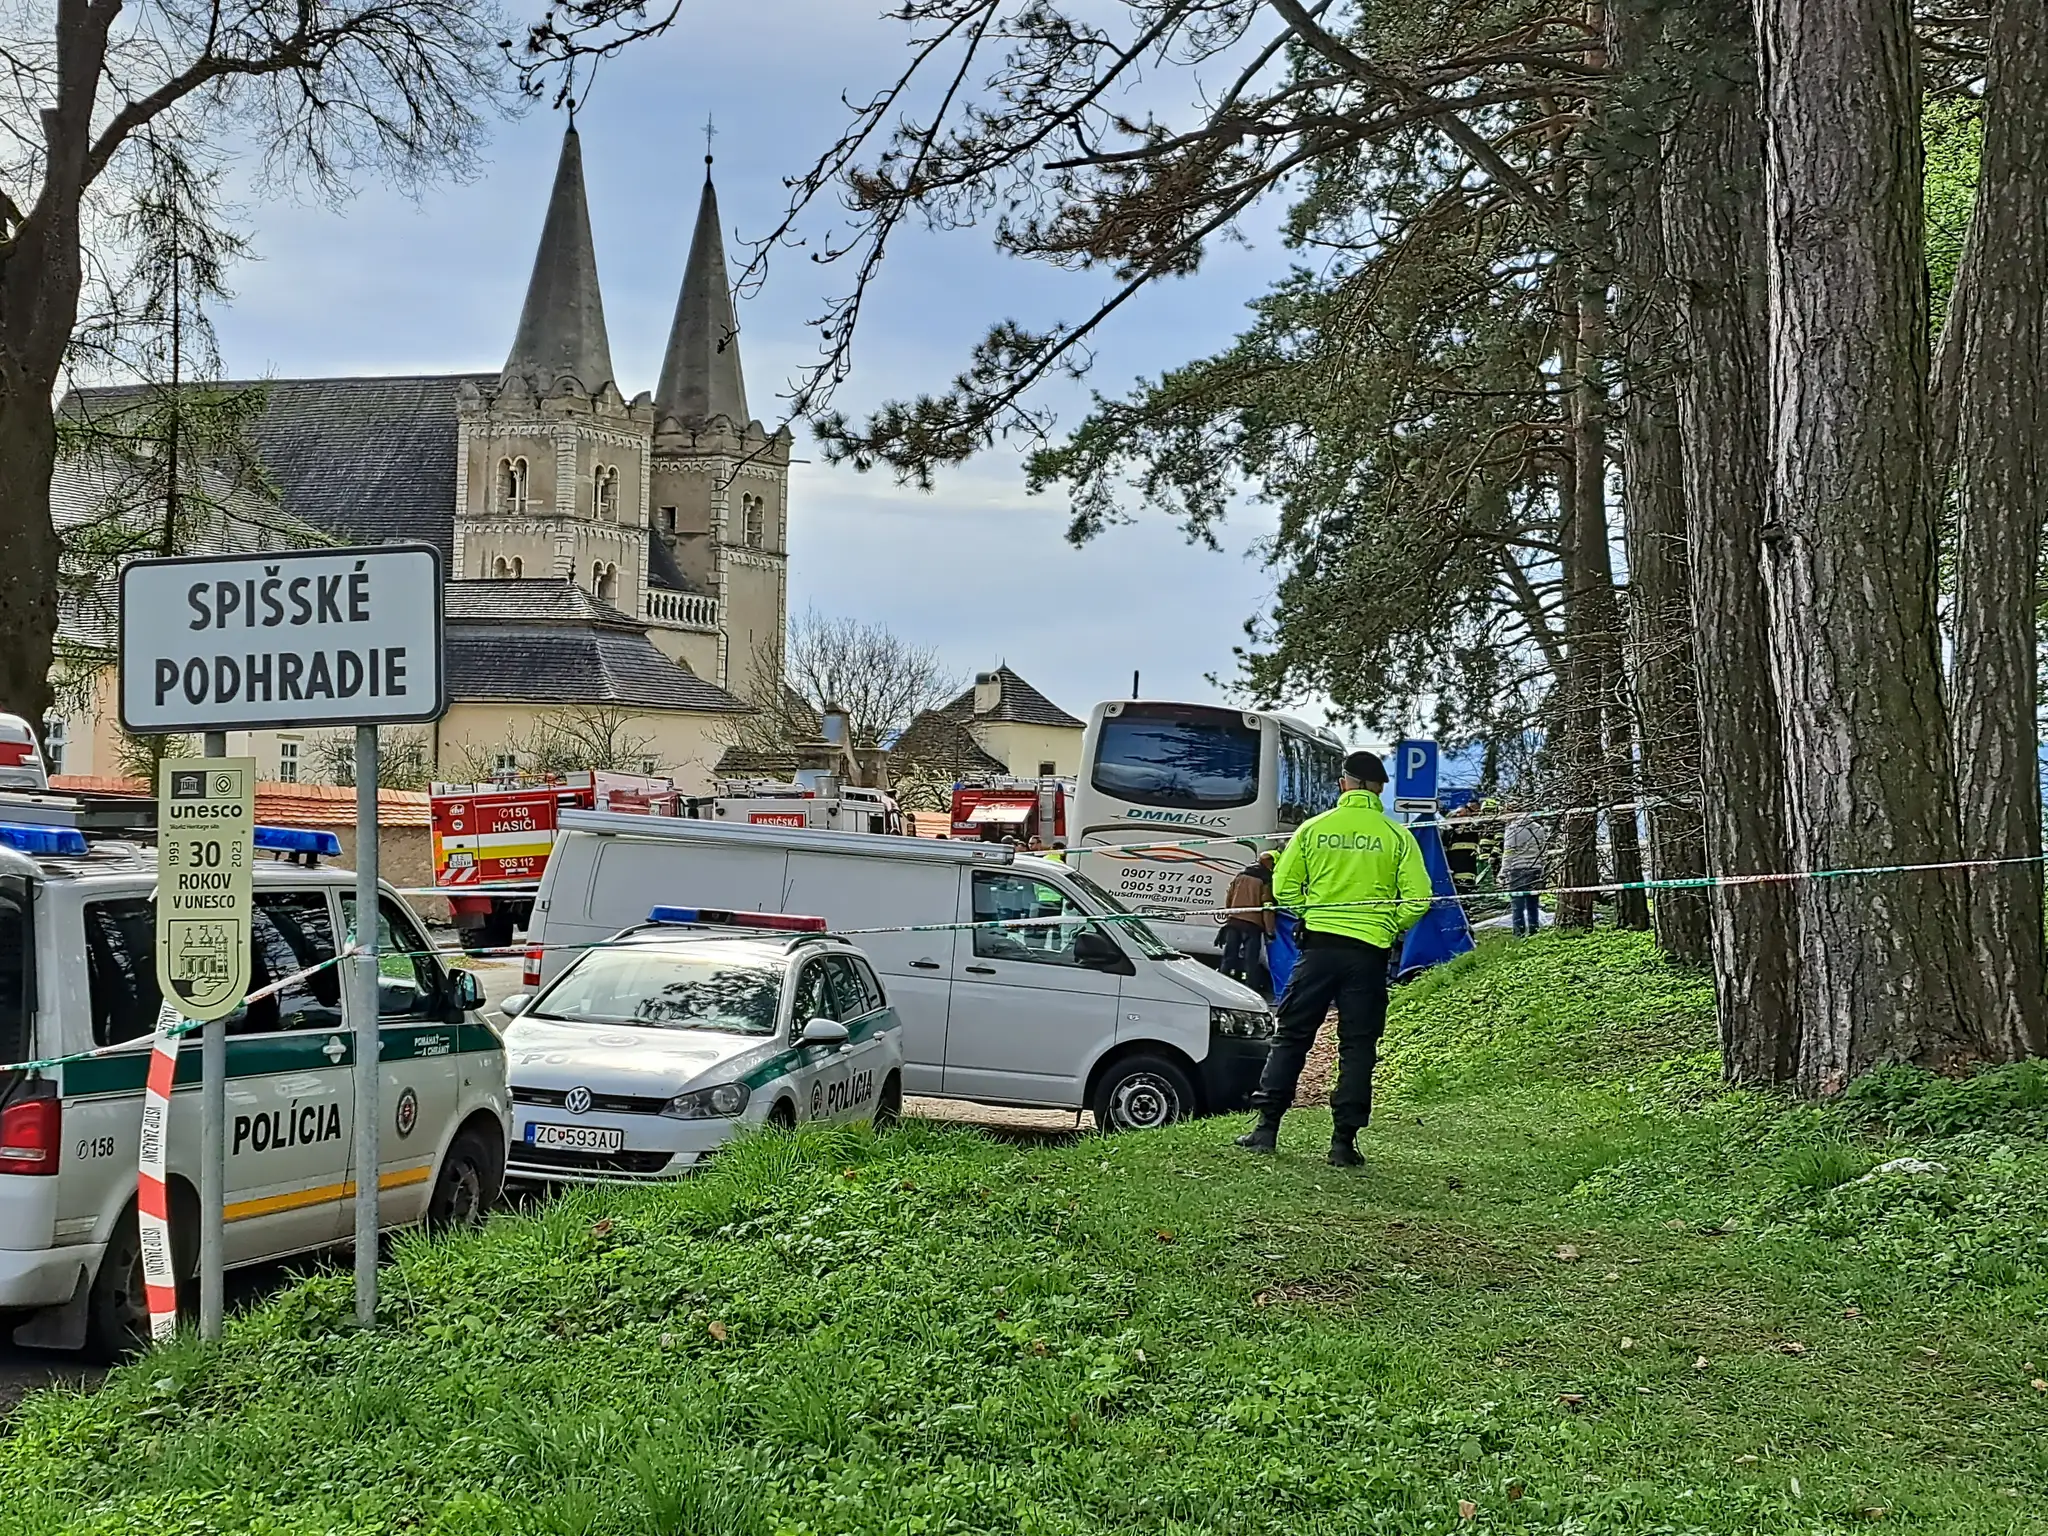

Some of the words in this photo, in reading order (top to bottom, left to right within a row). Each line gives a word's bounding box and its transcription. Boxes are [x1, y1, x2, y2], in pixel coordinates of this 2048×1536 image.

[187, 559, 370, 631] SPIŠSKÉ
[155, 647, 407, 706] PODHRADIE
[1406, 747, 1427, 780] P
[170, 804, 243, 819] unesco
[508, 807, 529, 818] 150
[492, 817, 536, 832] HASIČI
[1317, 831, 1384, 852] POLÍCIA
[168, 841, 180, 867] 1993
[189, 841, 221, 868] 30
[231, 840, 242, 868] 2023
[499, 858, 518, 868] SOS
[520, 857, 535, 867] 112
[178, 873, 232, 890] ROKOV
[1121, 868, 1155, 880] 0907
[1158, 871, 1184, 882] 977
[1187, 874, 1213, 885] 403
[1120, 880, 1154, 892] 0905
[1157, 884, 1182, 895] 931
[1187, 886, 1213, 898] 705
[173, 895, 182, 909] V
[185, 895, 236, 909] UNESCO
[825, 1067, 873, 1116] POLÍCIA
[144, 1106, 162, 1130] VSTUP
[232, 1098, 341, 1156] POLÍCIA
[90, 1136, 114, 1158] 158
[141, 1128, 163, 1165] ZAKÁZANÝ
[142, 1226, 162, 1247] VSTUP
[144, 1247, 171, 1277] ZAKÁZANÝ
